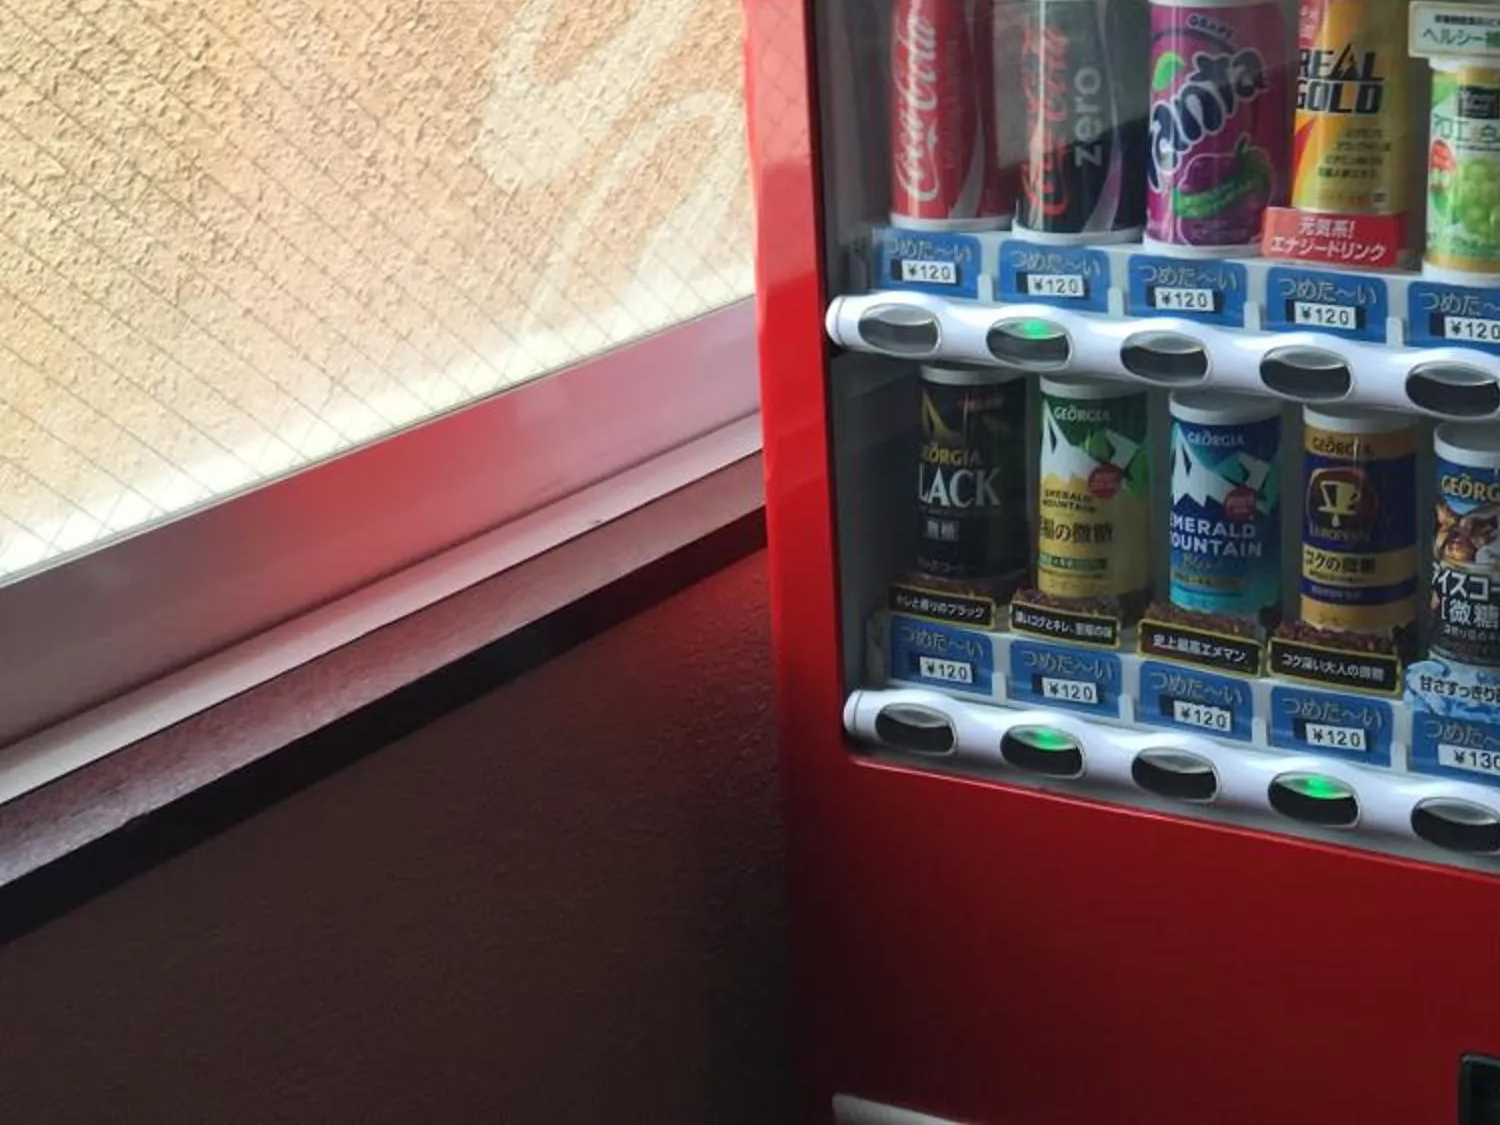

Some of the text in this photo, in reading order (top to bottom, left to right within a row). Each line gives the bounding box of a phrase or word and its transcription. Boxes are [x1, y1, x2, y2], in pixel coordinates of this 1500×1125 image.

[1073, 66, 1104, 168] zero
[1271, 236, 1386, 262] エナジードリンク
[906, 264, 952, 281] ¥120
[1032, 278, 1080, 295] ¥120
[1160, 290, 1209, 309] ¥120
[1300, 306, 1351, 326] ¥120
[924, 662, 969, 681] ¥120
[1048, 682, 1094, 702] ¥120
[1178, 709, 1228, 730] ¥120
[1311, 728, 1362, 749] ¥120
